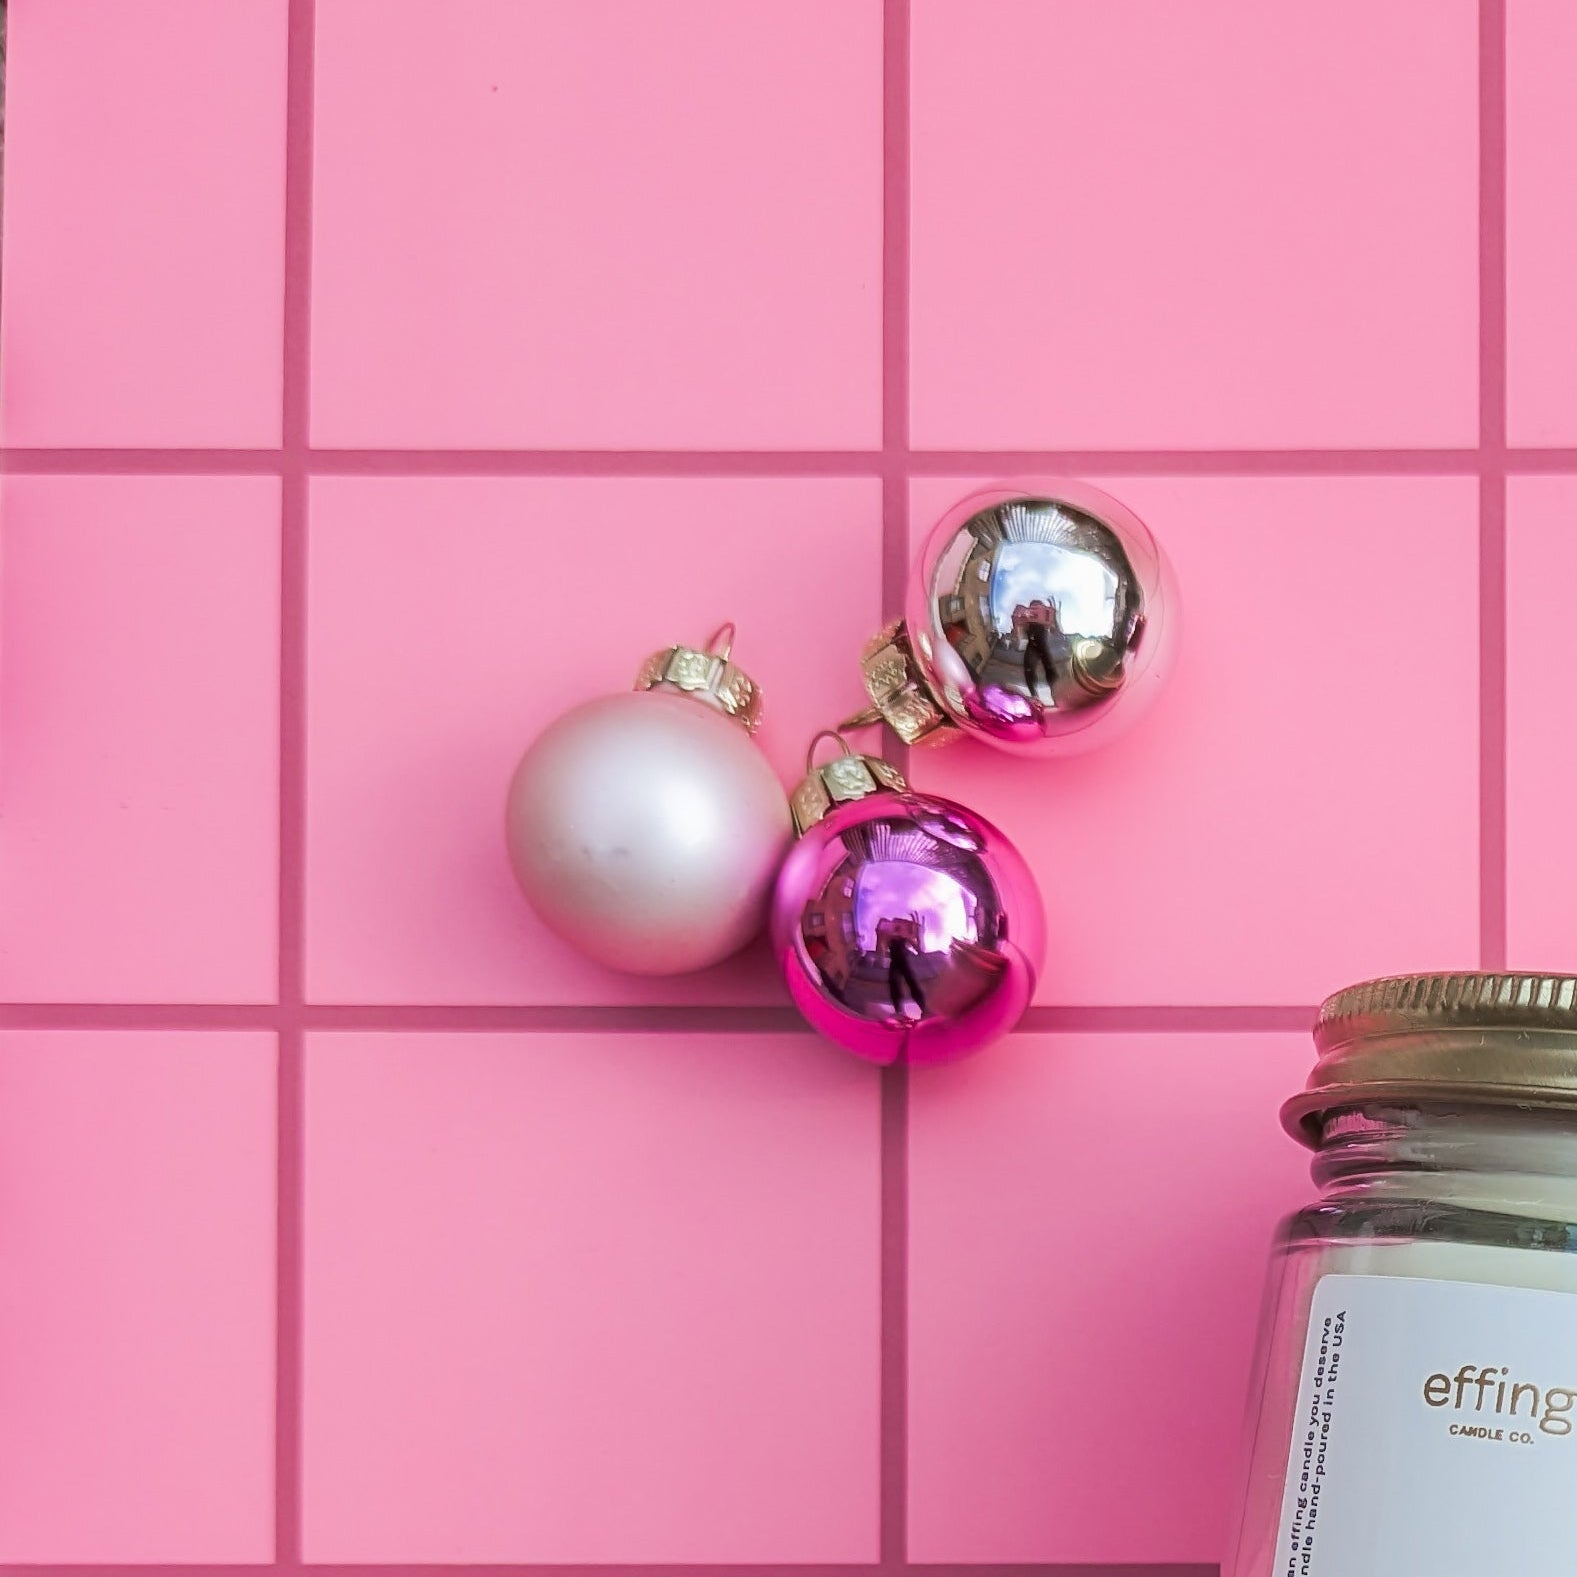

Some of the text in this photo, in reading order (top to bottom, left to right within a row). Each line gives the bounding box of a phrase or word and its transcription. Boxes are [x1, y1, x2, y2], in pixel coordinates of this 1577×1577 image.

[1332, 1311, 1347, 1347] USA
[1314, 1317, 1332, 1388] deserve
[1327, 1353, 1340, 1382] the
[1309, 1394, 1320, 1427] you
[1323, 1389, 1335, 1405] in
[1423, 1365, 1577, 1435] effing
[1449, 1424, 1535, 1445] CANDLE CO.
[1300, 1431, 1315, 1492] candle
[1305, 1412, 1332, 1530] hand-poured
[1291, 1497, 1308, 1551] effing
